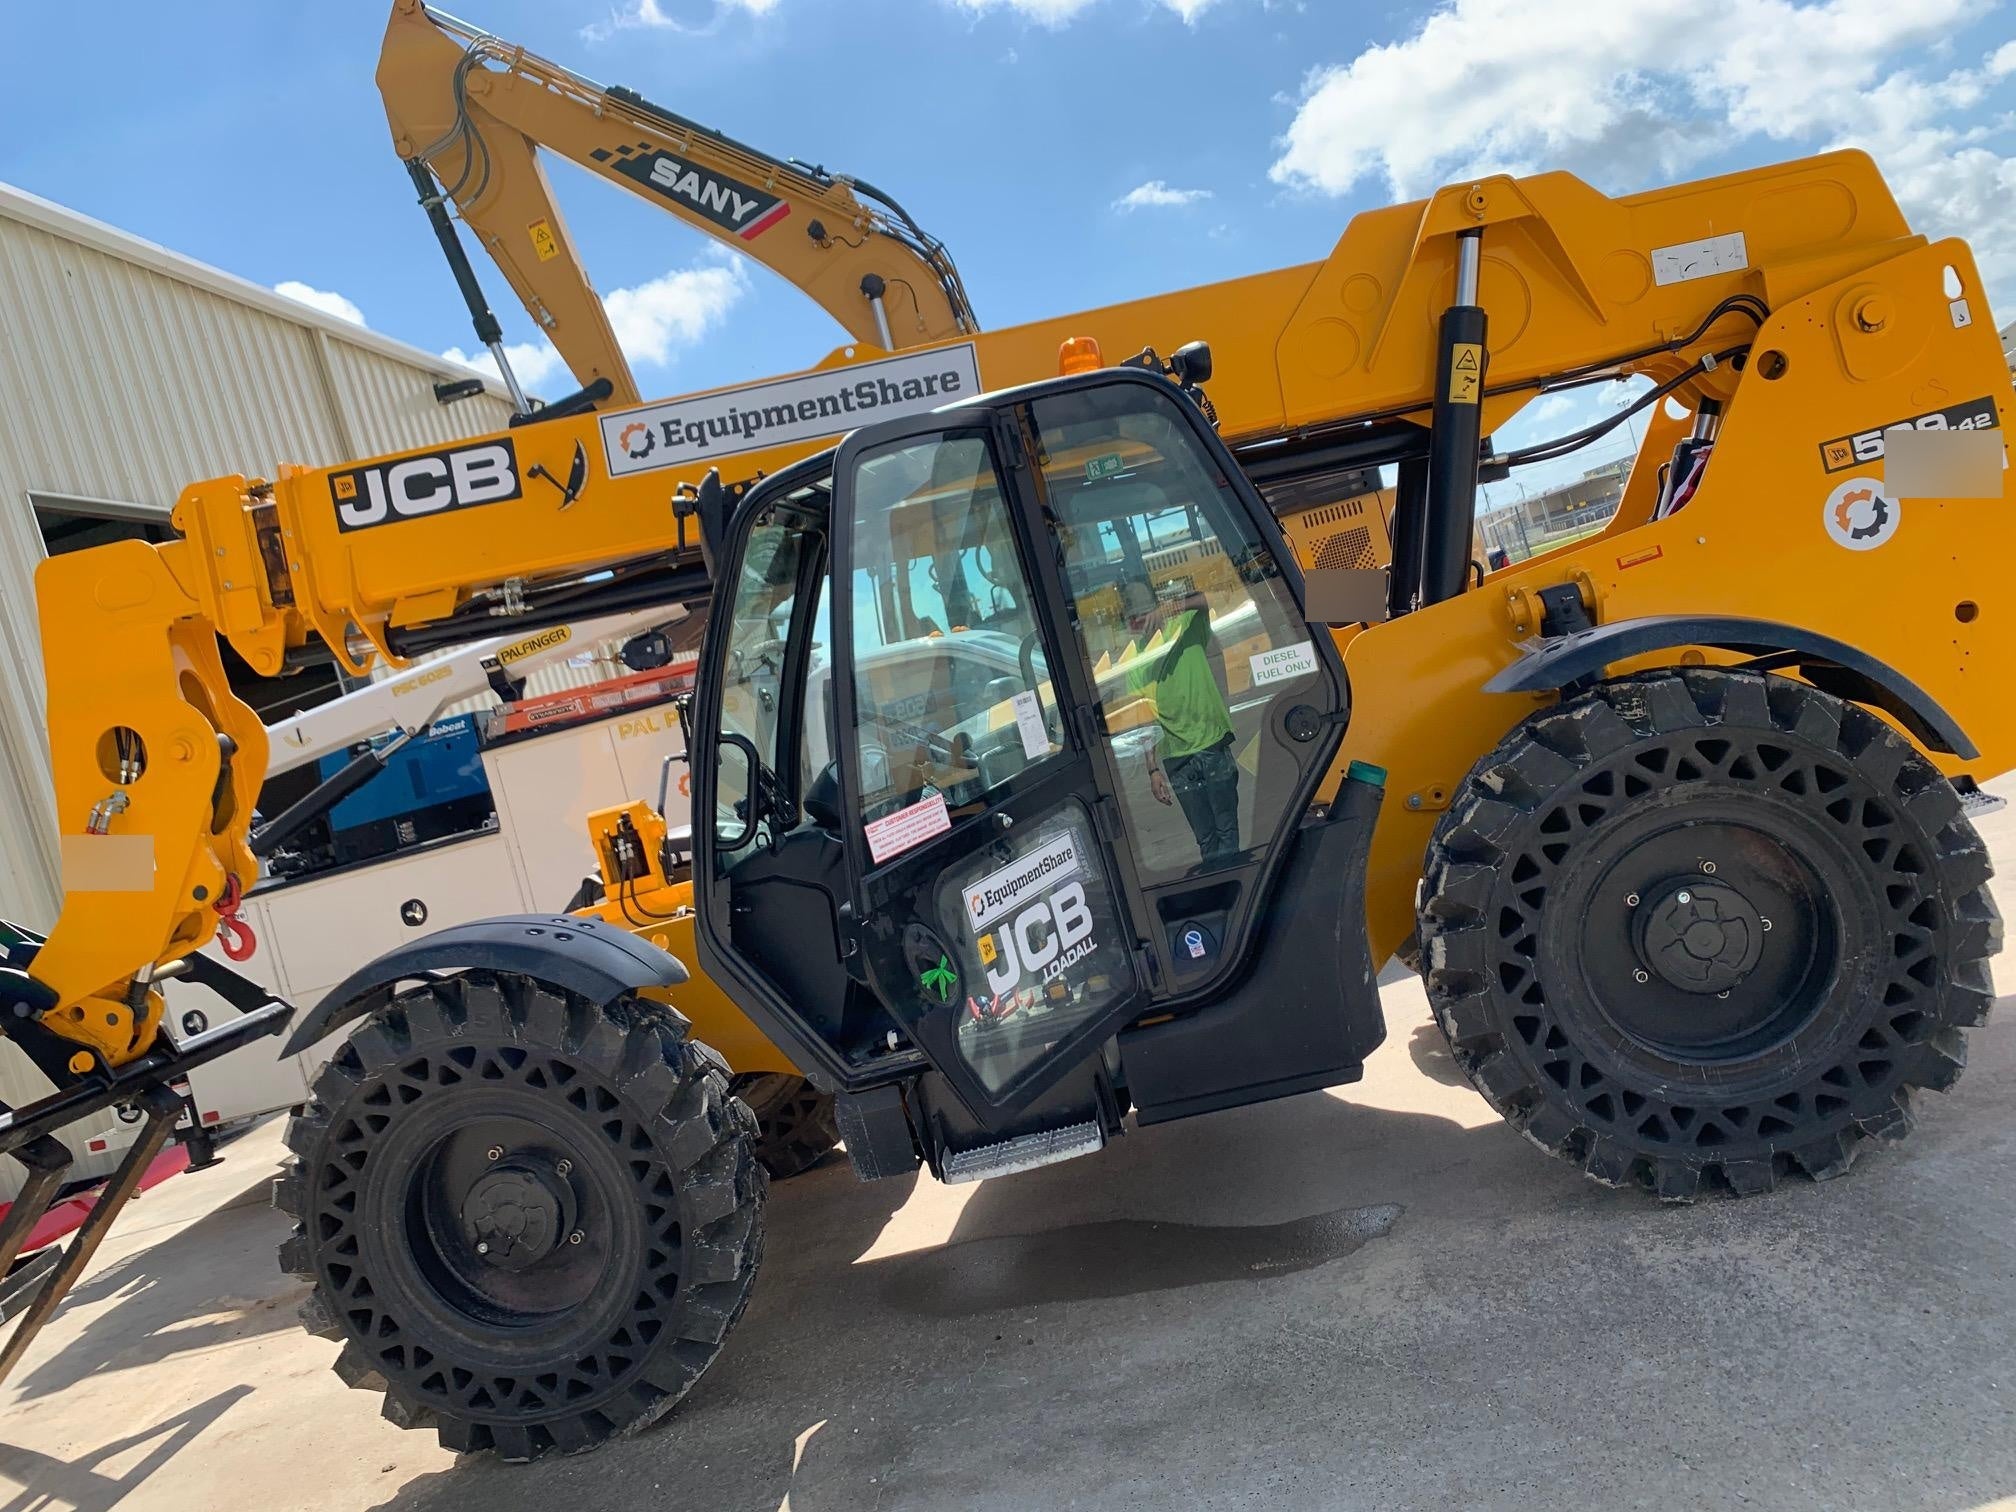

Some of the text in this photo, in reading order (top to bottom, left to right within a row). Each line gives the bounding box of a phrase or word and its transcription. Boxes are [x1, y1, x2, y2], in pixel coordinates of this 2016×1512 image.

[650, 157, 759, 222] SANY
[660, 369, 961, 449] EquipmentShare
[1831, 447, 1848, 462] JCB
[339, 445, 516, 527] JCB
[500, 628, 568, 662] PALFINGER
[1263, 649, 1300, 665] DIESEL
[1256, 659, 1312, 680] FUEL ONLY
[429, 720, 466, 737] Bobcat
[618, 717, 661, 740] PAL
[884, 812, 909, 827] CUSTOMER
[984, 848, 1073, 907] EquipmentShare
[986, 881, 1094, 997] JCB
[1043, 936, 1099, 983] LOADALL
